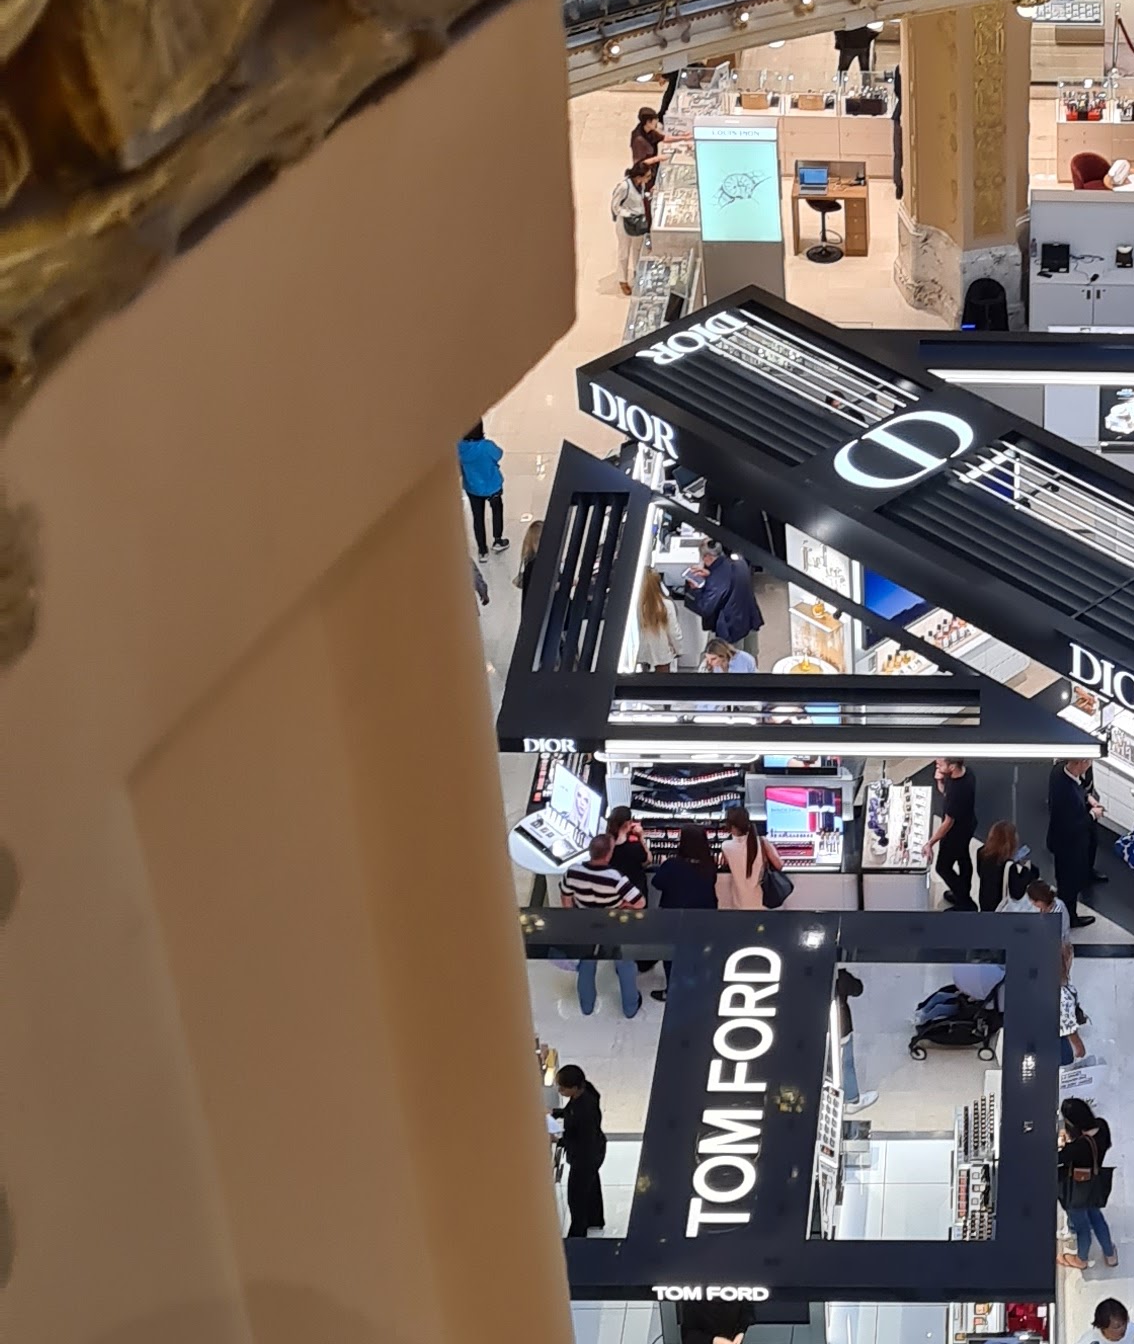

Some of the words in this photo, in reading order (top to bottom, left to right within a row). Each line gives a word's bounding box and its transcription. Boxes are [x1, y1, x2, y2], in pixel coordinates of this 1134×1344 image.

[635, 311, 748, 365] DIOR
[589, 382, 679, 459] DIOR
[523, 738, 577, 752] DIOR
[706, 946, 782, 1092] FORD
[685, 1109, 763, 1238] TOM
[652, 1285, 702, 1301] TOM
[706, 1286, 769, 1302] FORD
